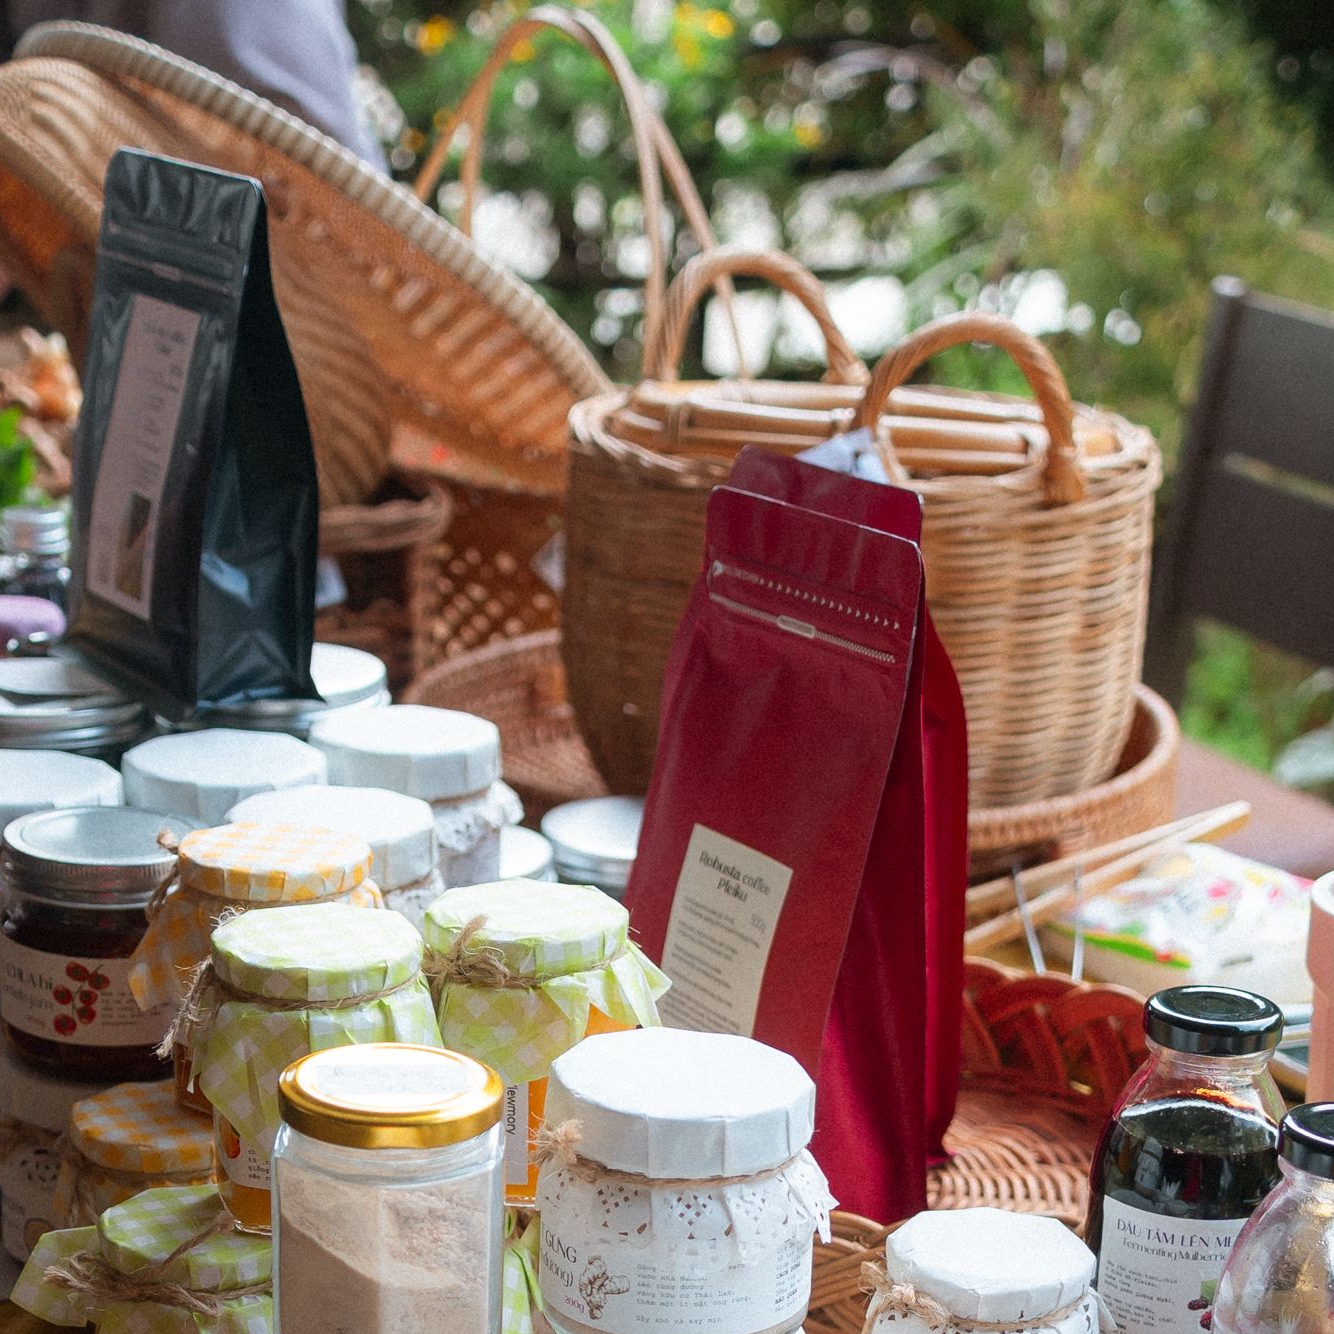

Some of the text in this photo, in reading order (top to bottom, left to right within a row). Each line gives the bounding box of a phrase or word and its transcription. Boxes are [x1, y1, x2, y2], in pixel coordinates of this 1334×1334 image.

[699, 850, 741, 881] Robusta
[1123, 1237, 1177, 1261] Fermenting
[1214, 1236, 1232, 1248] ME
[564, 1295, 585, 1313] 200g
